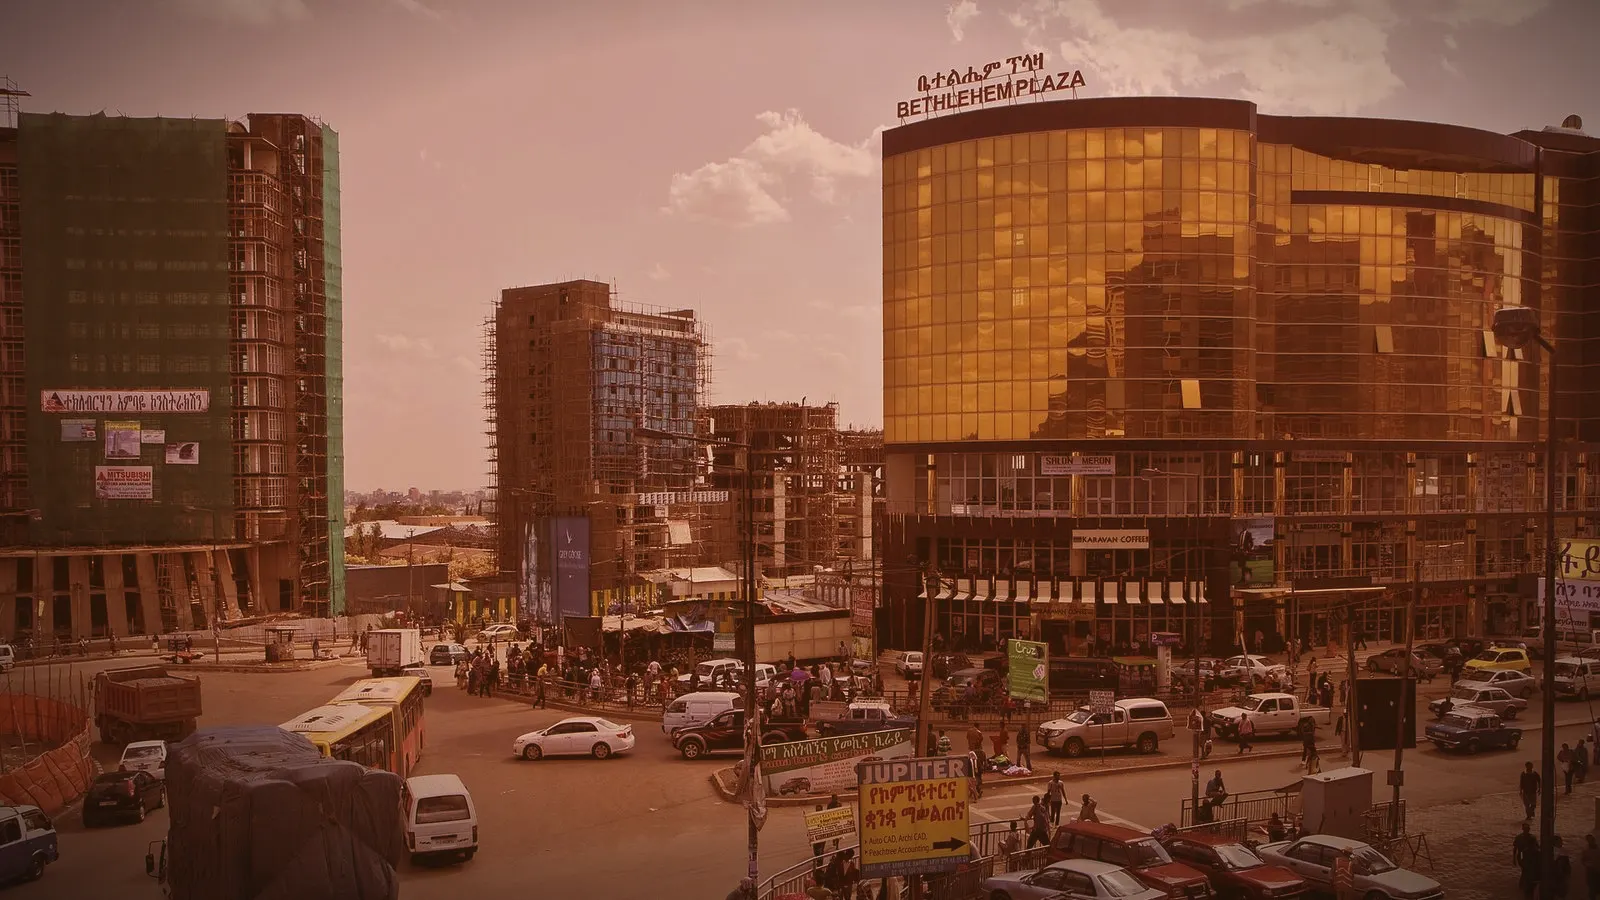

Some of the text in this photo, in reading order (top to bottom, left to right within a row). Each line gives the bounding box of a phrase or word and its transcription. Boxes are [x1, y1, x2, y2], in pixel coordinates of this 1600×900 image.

[897, 70, 1086, 118] BETHLEHEM PLAZA
[862, 759, 964, 784] JUPITER
